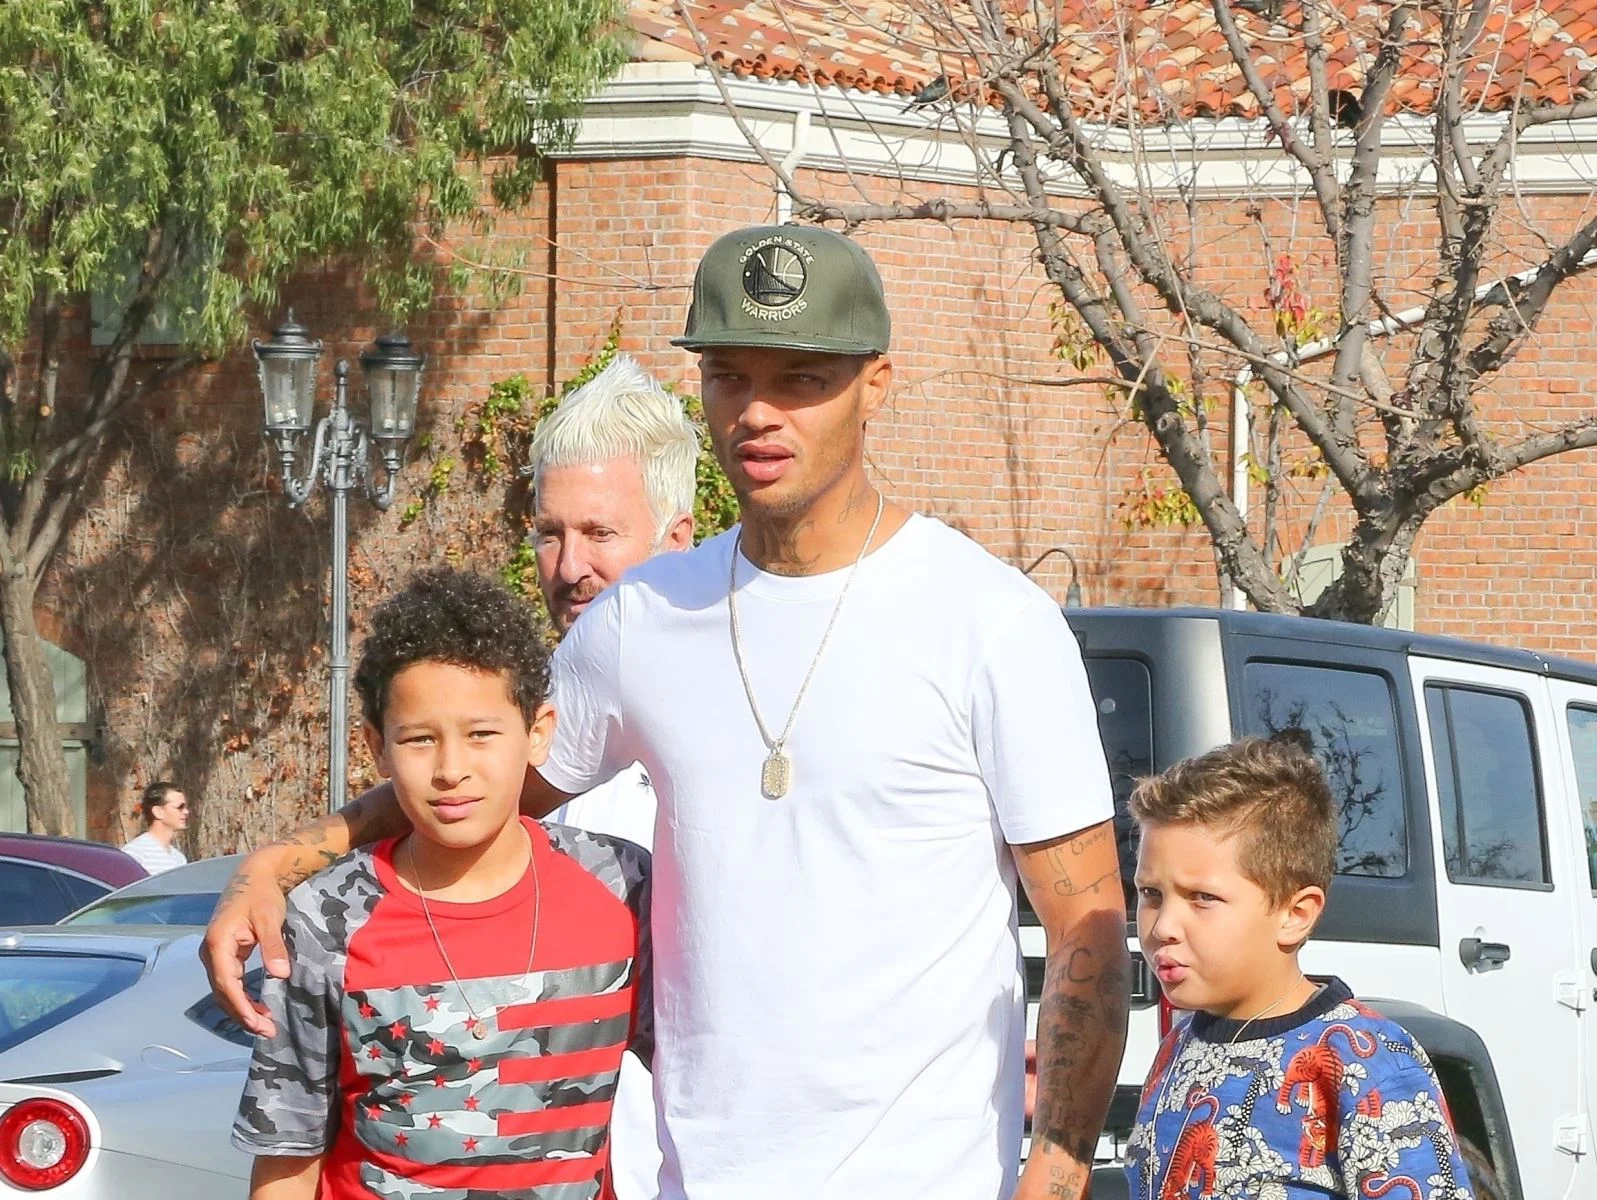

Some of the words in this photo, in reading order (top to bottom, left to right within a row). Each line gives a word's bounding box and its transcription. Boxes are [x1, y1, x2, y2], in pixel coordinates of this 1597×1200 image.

[739, 235, 783, 263] GOLDEN
[784, 239, 815, 265] STATE
[741, 298, 808, 321] WARRIORS
